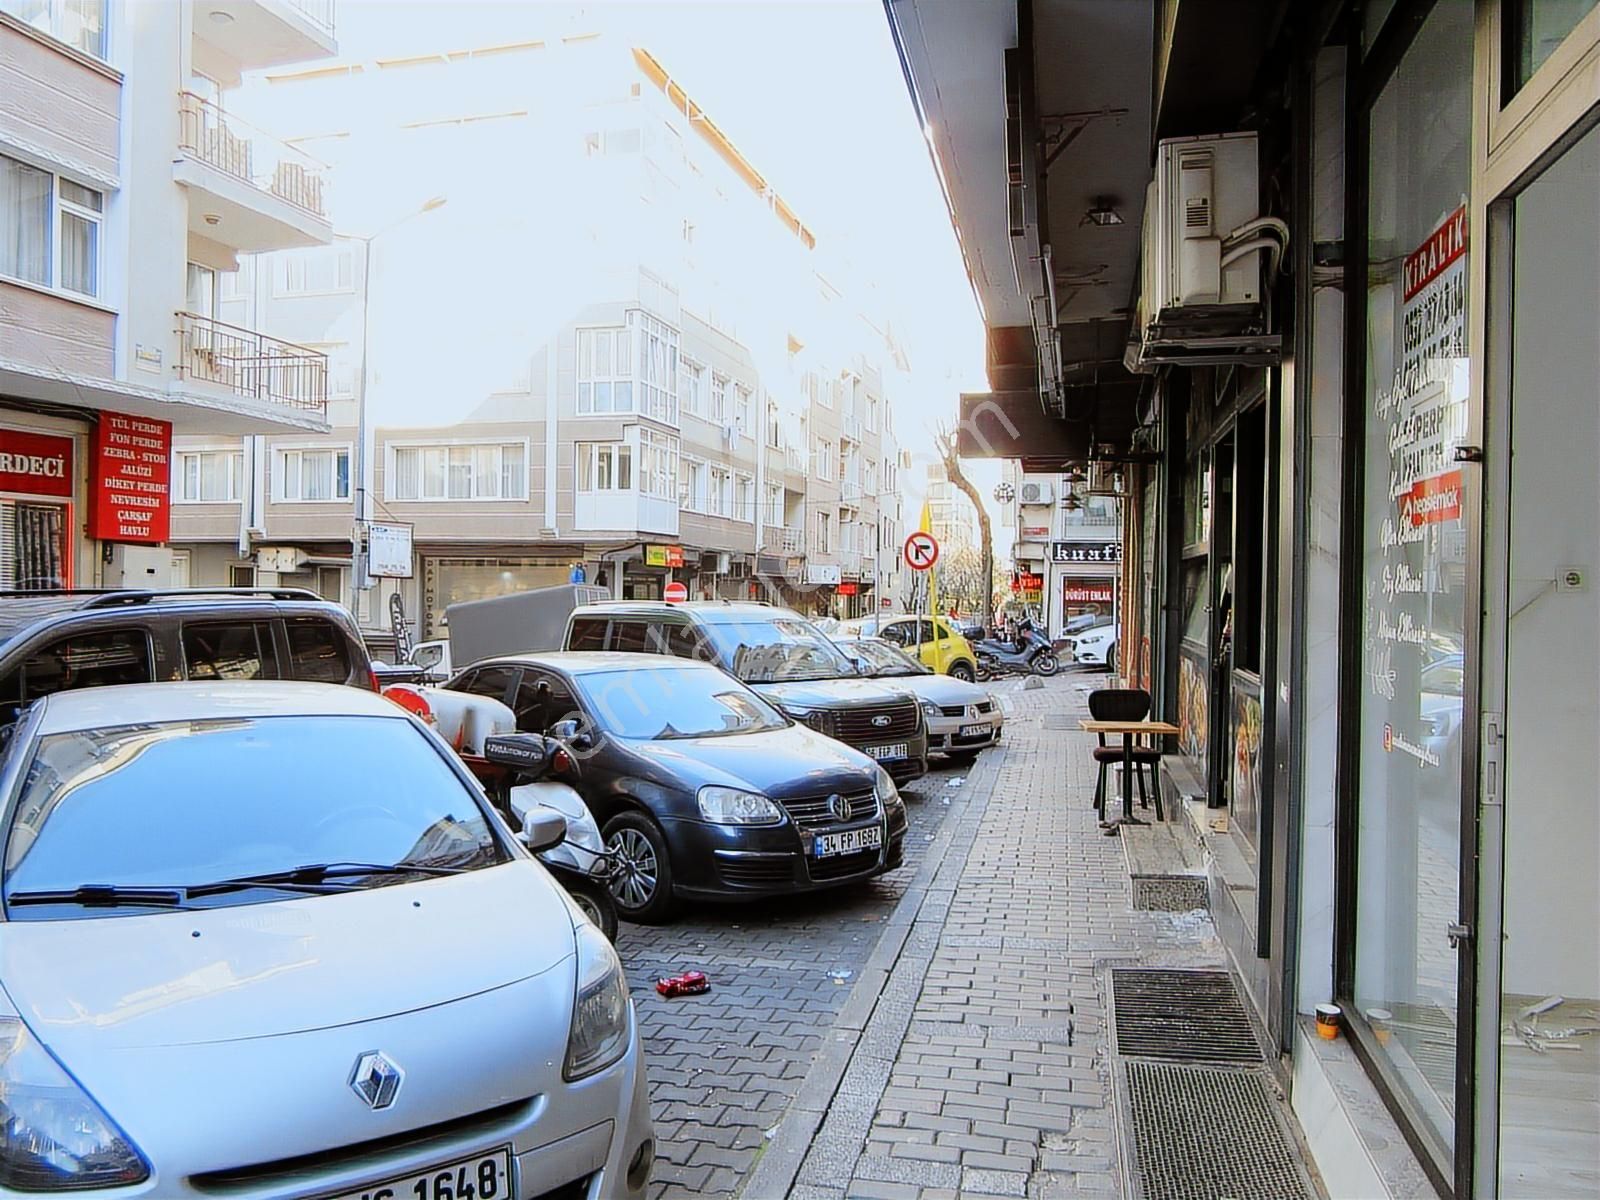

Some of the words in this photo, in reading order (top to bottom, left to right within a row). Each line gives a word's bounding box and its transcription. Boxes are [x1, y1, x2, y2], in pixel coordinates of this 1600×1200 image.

[111, 416, 130, 430] TÜL
[132, 421, 163, 435] PERDE
[110, 432, 130, 444] FON
[132, 436, 163, 449] PERDE
[103, 446, 135, 460] ZEBRA
[105, 476, 136, 490] DİKEY
[137, 481, 168, 494] PERDE
[110, 494, 160, 508] NEVRESİM
[117, 510, 153, 524] ÇARŞAF
[119, 525, 150, 537] HAVLU
[1090, 590, 1111, 601] EMLAK
[824, 836, 837, 853] 34
[840, 832, 854, 850] FP
[413, 1159, 498, 1200] 1648
